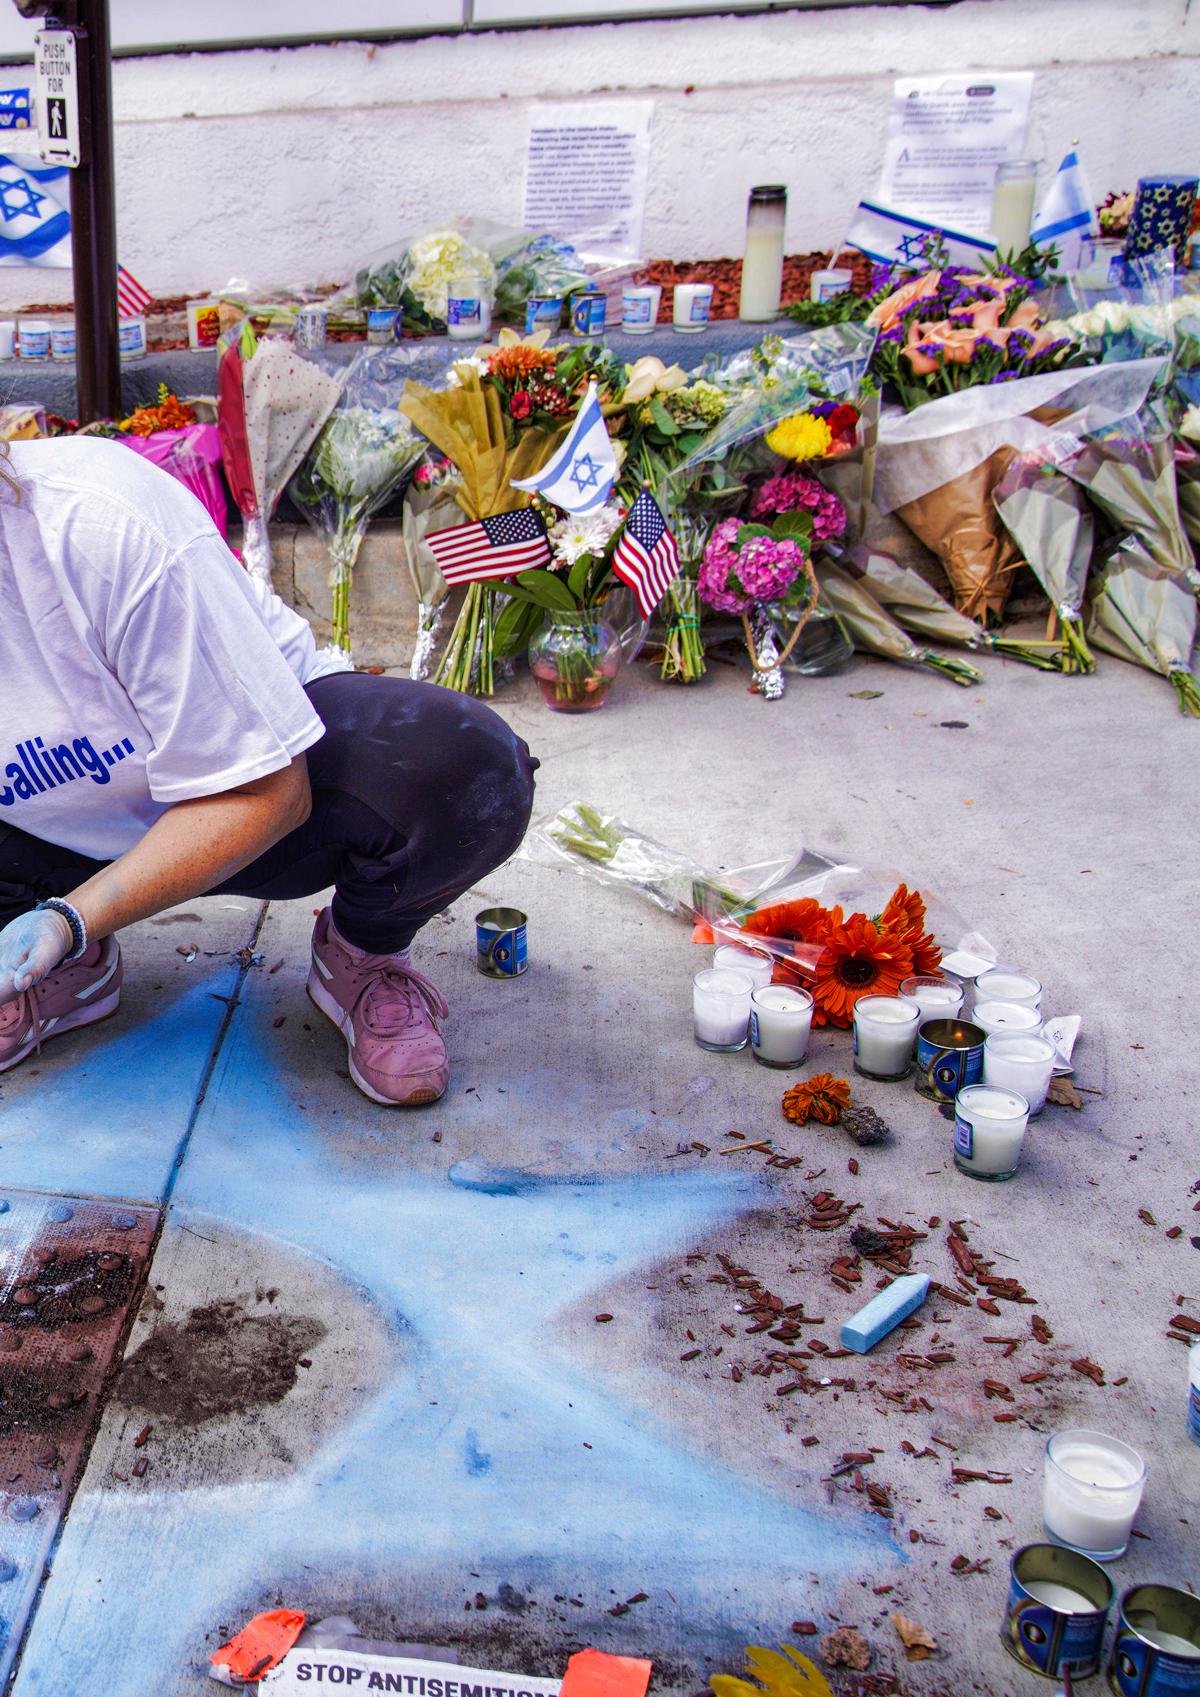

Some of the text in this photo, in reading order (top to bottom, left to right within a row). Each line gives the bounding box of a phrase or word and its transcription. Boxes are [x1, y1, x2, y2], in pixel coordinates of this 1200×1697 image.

[43, 44, 65, 58] PUSH
[40, 61, 71, 75] BUTTON
[48, 78, 63, 92] FOR
[296, 1663, 560, 1697] STOP ANTISEMIT
